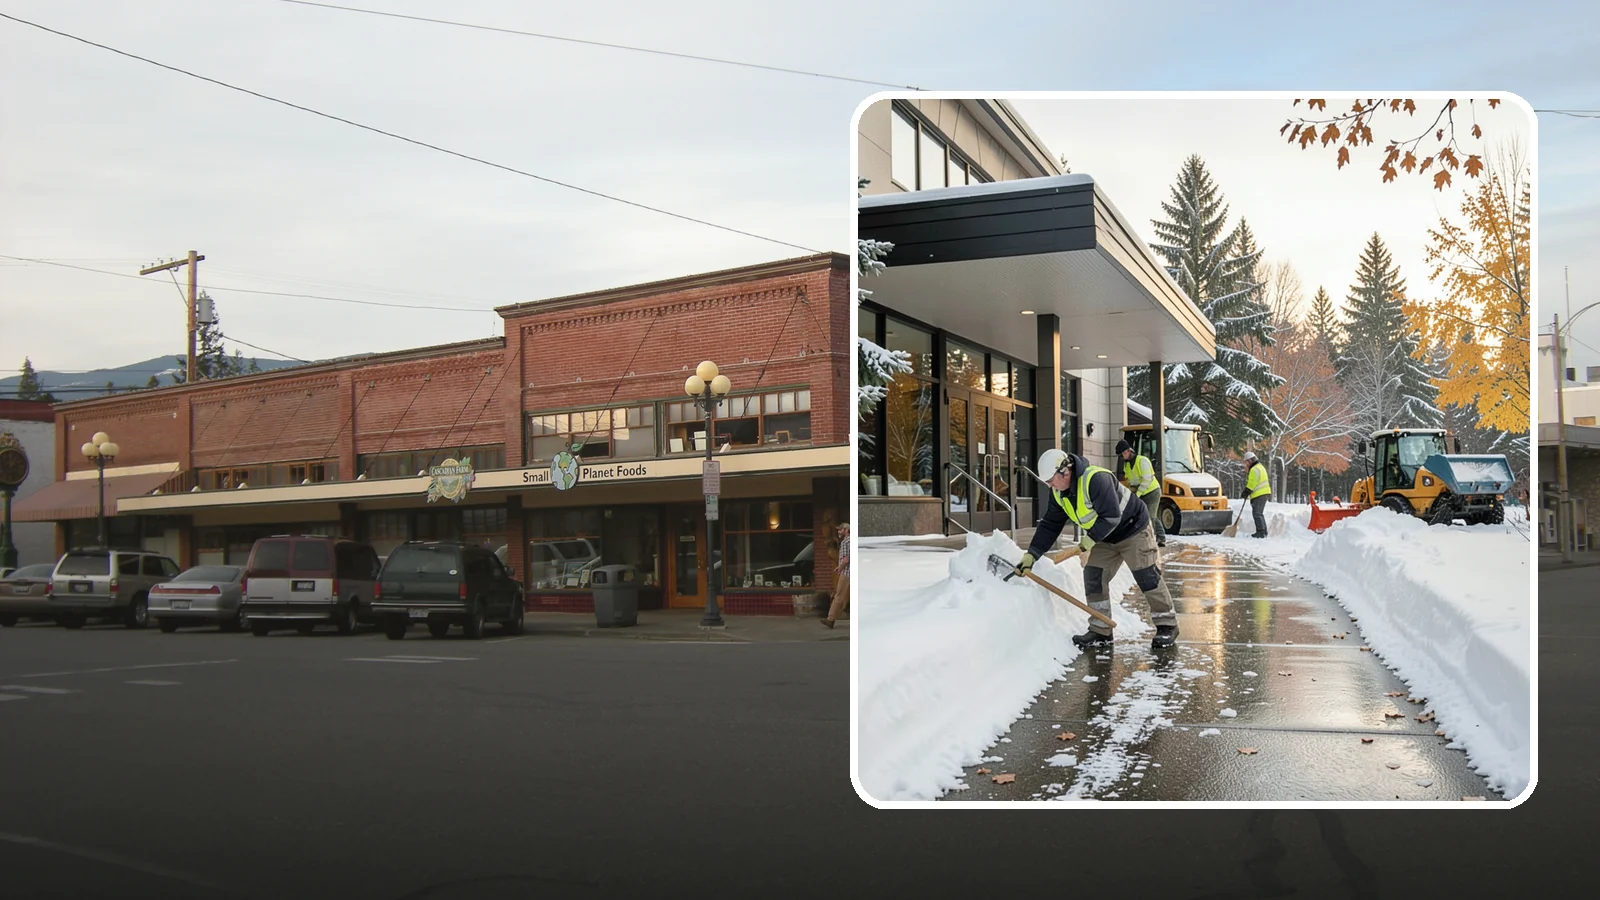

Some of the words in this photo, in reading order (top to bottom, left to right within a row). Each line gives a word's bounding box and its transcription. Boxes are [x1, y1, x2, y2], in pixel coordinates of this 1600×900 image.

[523, 471, 549, 483] Small
[582, 467, 614, 479] Planet
[616, 464, 647, 477] Foods
